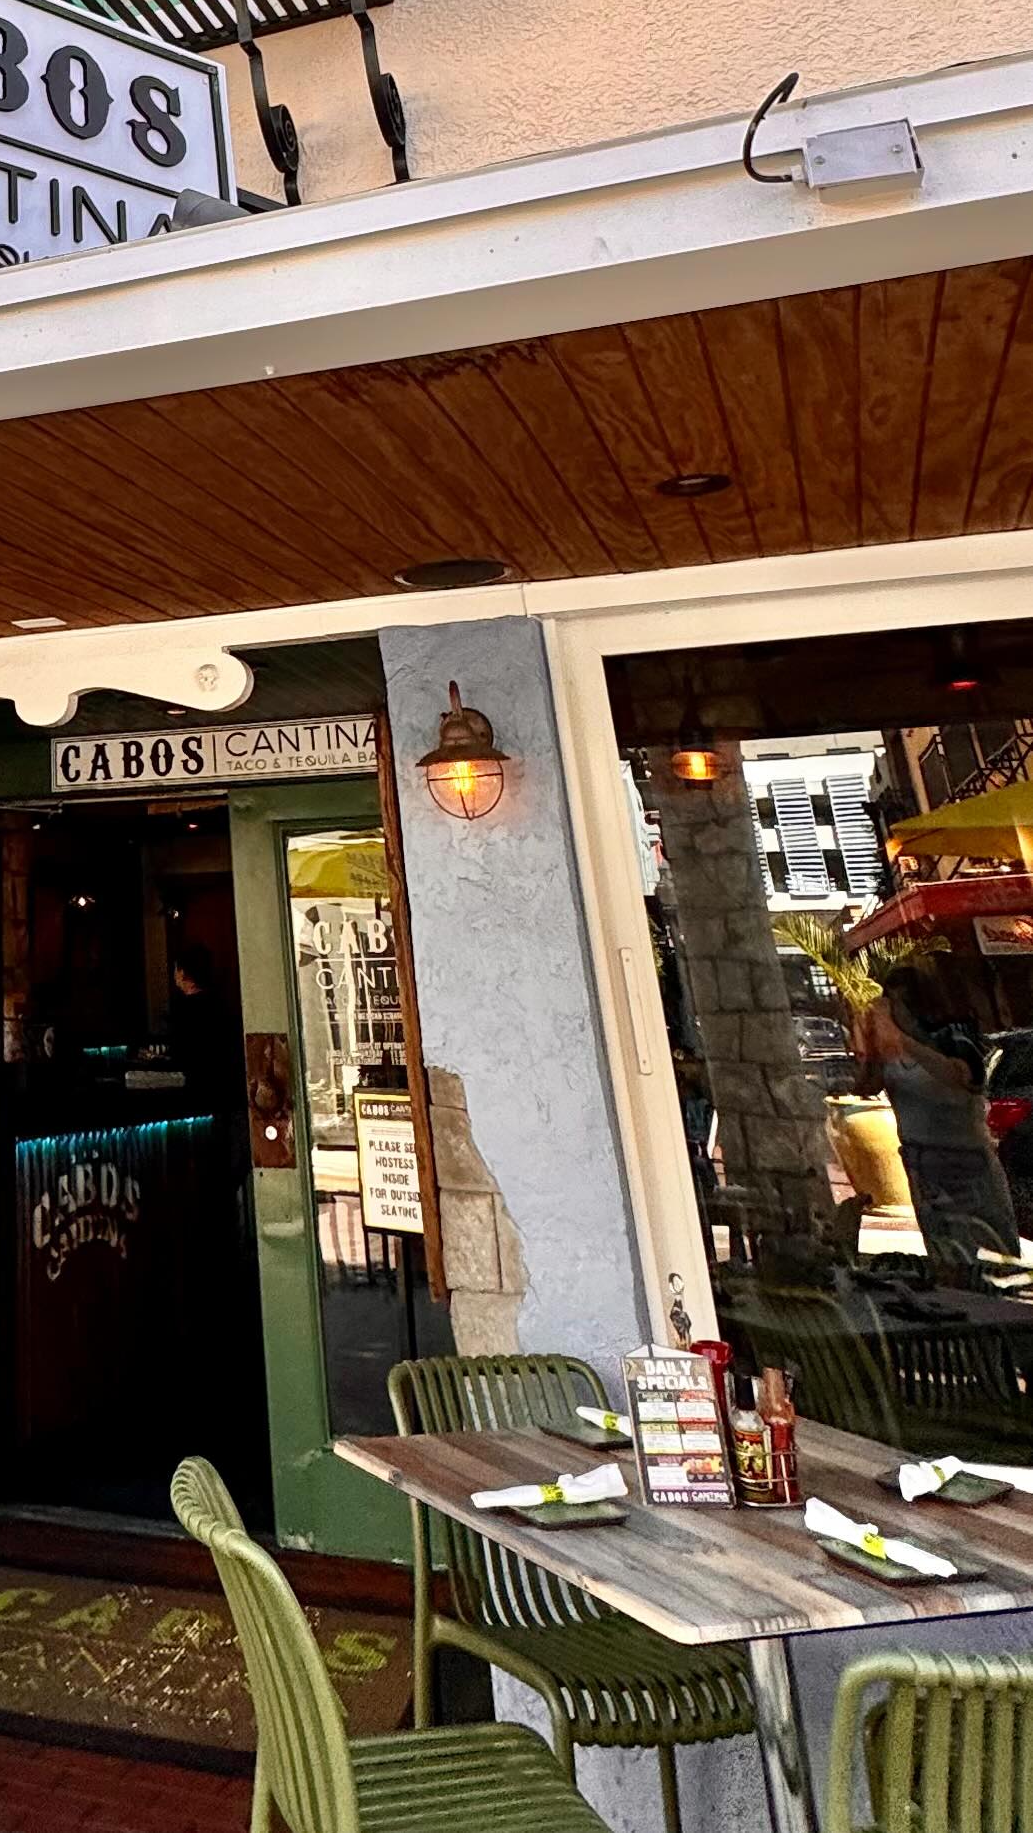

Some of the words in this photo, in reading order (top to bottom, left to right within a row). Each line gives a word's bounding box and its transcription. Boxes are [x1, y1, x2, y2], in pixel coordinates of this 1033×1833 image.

[59, 735, 205, 782] CABOS
[226, 759, 267, 771] TACO
[272, 757, 281, 768] &
[288, 754, 351, 767] TEQUILA
[358, 751, 378, 763] BA
[313, 920, 396, 955] CAB
[368, 1139, 401, 1153] PLEASE
[403, 1141, 416, 1154] SE
[375, 1156, 415, 1170] HOSTESS
[382, 1173, 410, 1185] INSIDE
[369, 1187, 387, 1200] FOR
[390, 1189, 421, 1202] OUTSID
[381, 1204, 418, 1220] SEATING
[644, 1359, 692, 1375] DAILY
[636, 1375, 708, 1390] SPECIALS
